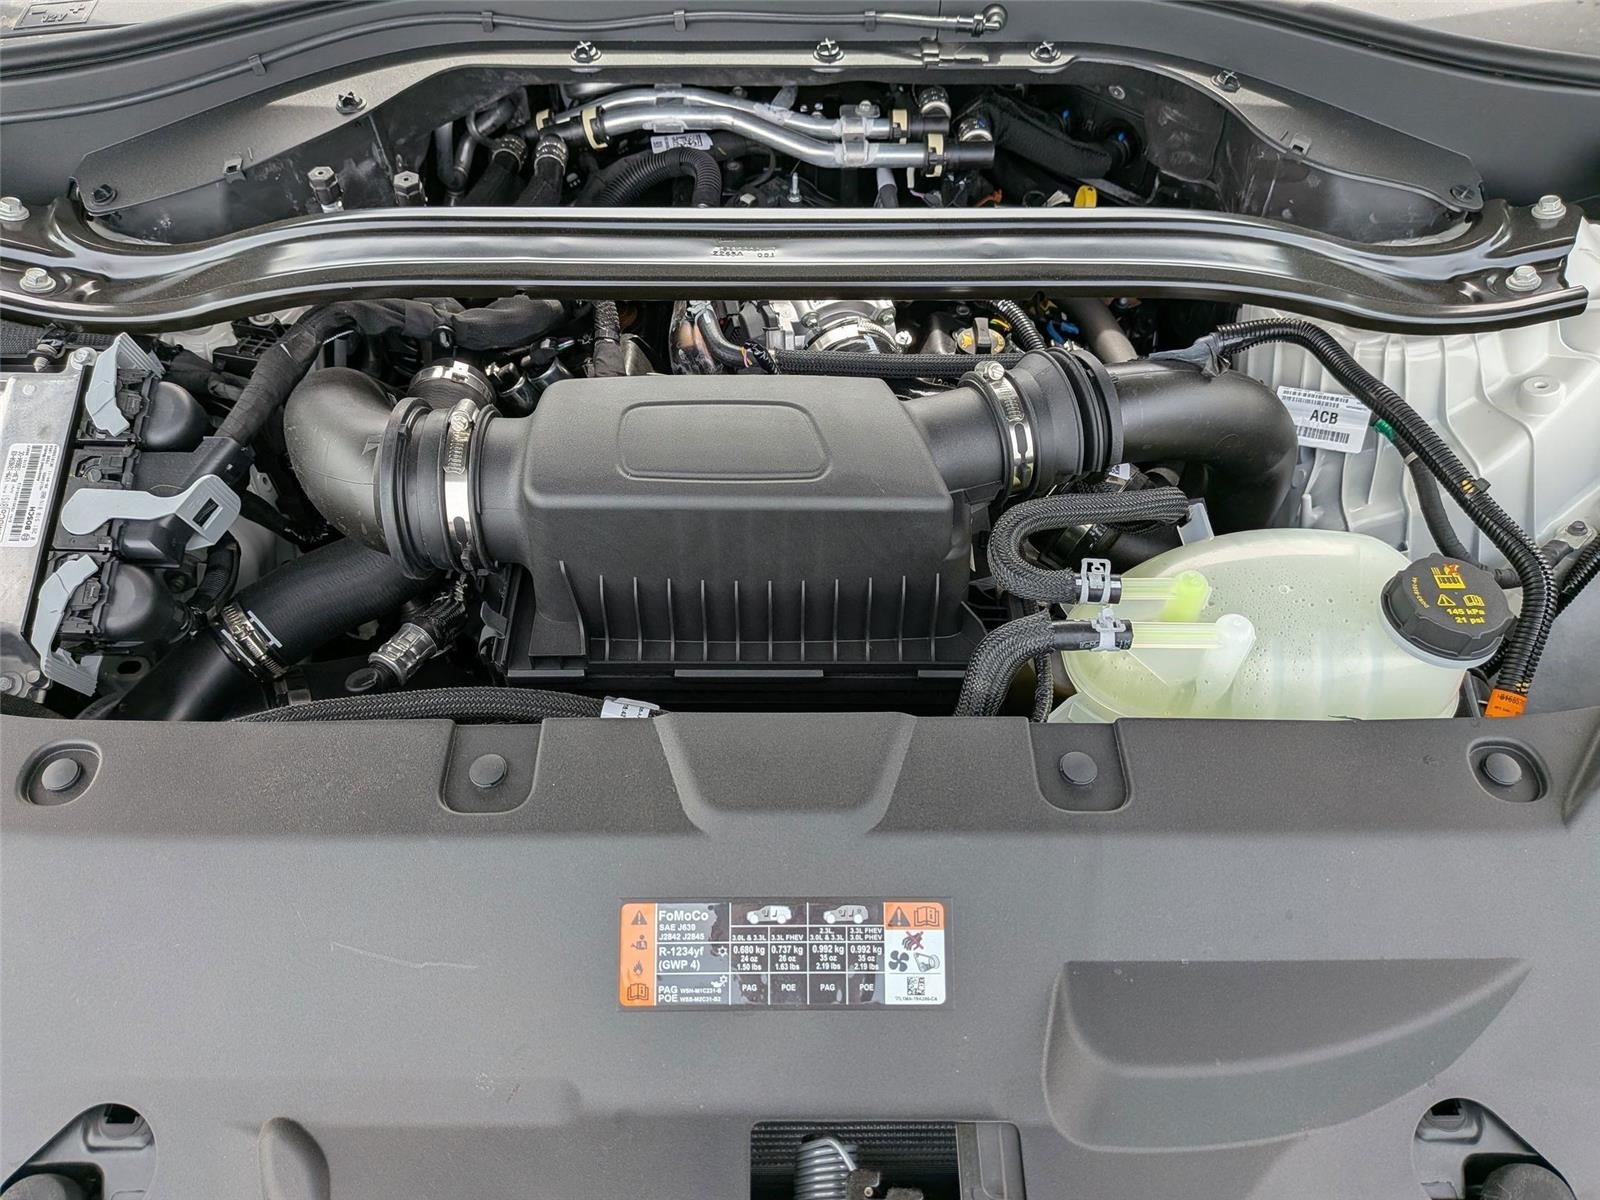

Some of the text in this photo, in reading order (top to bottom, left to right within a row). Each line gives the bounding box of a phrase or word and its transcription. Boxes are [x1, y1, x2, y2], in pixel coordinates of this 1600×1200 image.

[1309, 409, 1339, 425] ACB
[24, 506, 37, 531] BOSCH
[1446, 608, 1486, 616] 145 kPa
[1454, 616, 1486, 625] 21 psi
[658, 910, 709, 921] FoMoCo
[659, 923, 677, 931] SAE
[659, 933, 705, 941] J2842 J2845
[658, 946, 705, 959] R-1234yf
[733, 945, 766, 956] 0.680 kg
[771, 945, 804, 956] 0.737 kg
[812, 945, 845, 956] 0.992 kg
[850, 945, 883, 956] 0.992 kg
[658, 959, 701, 972] (GWP 4)
[737, 963, 762, 971] 1.50 lbs
[775, 963, 800, 971] 1.63 lbs
[658, 986, 678, 994] PAG
[741, 984, 758, 992] PAG
[781, 984, 797, 992] POE
[820, 984, 836, 992] PAG
[859, 984, 874, 992] POE
[658, 994, 678, 1003] POE
